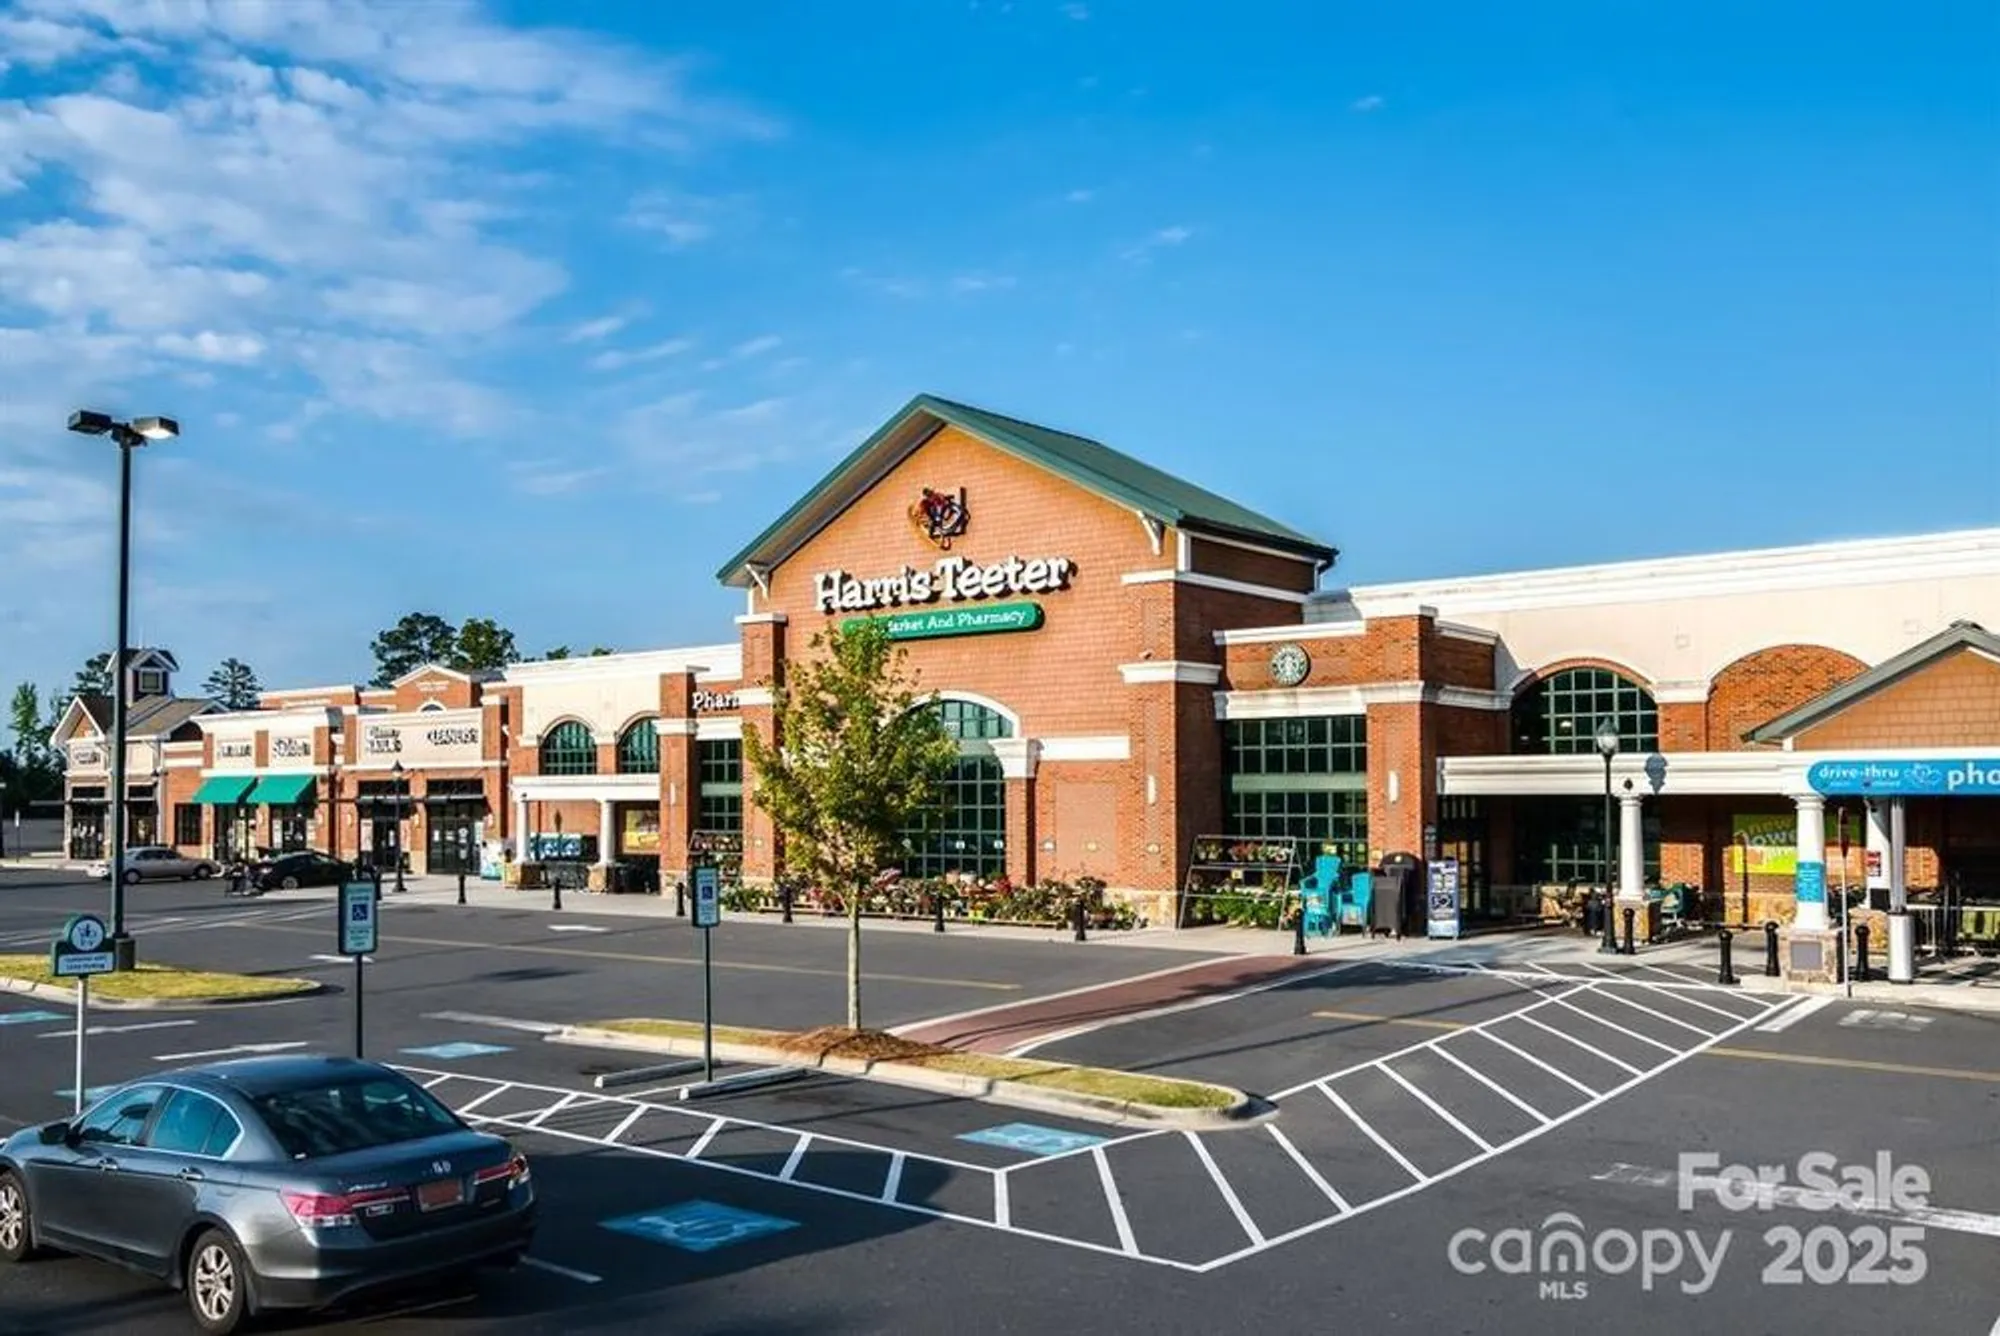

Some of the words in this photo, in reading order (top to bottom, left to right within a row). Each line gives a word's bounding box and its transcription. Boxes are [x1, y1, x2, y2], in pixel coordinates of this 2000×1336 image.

[813, 567, 932, 612] Harris
[936, 555, 1070, 600] Teeter
[926, 614, 955, 630] And
[957, 610, 1026, 627] Pharmacy
